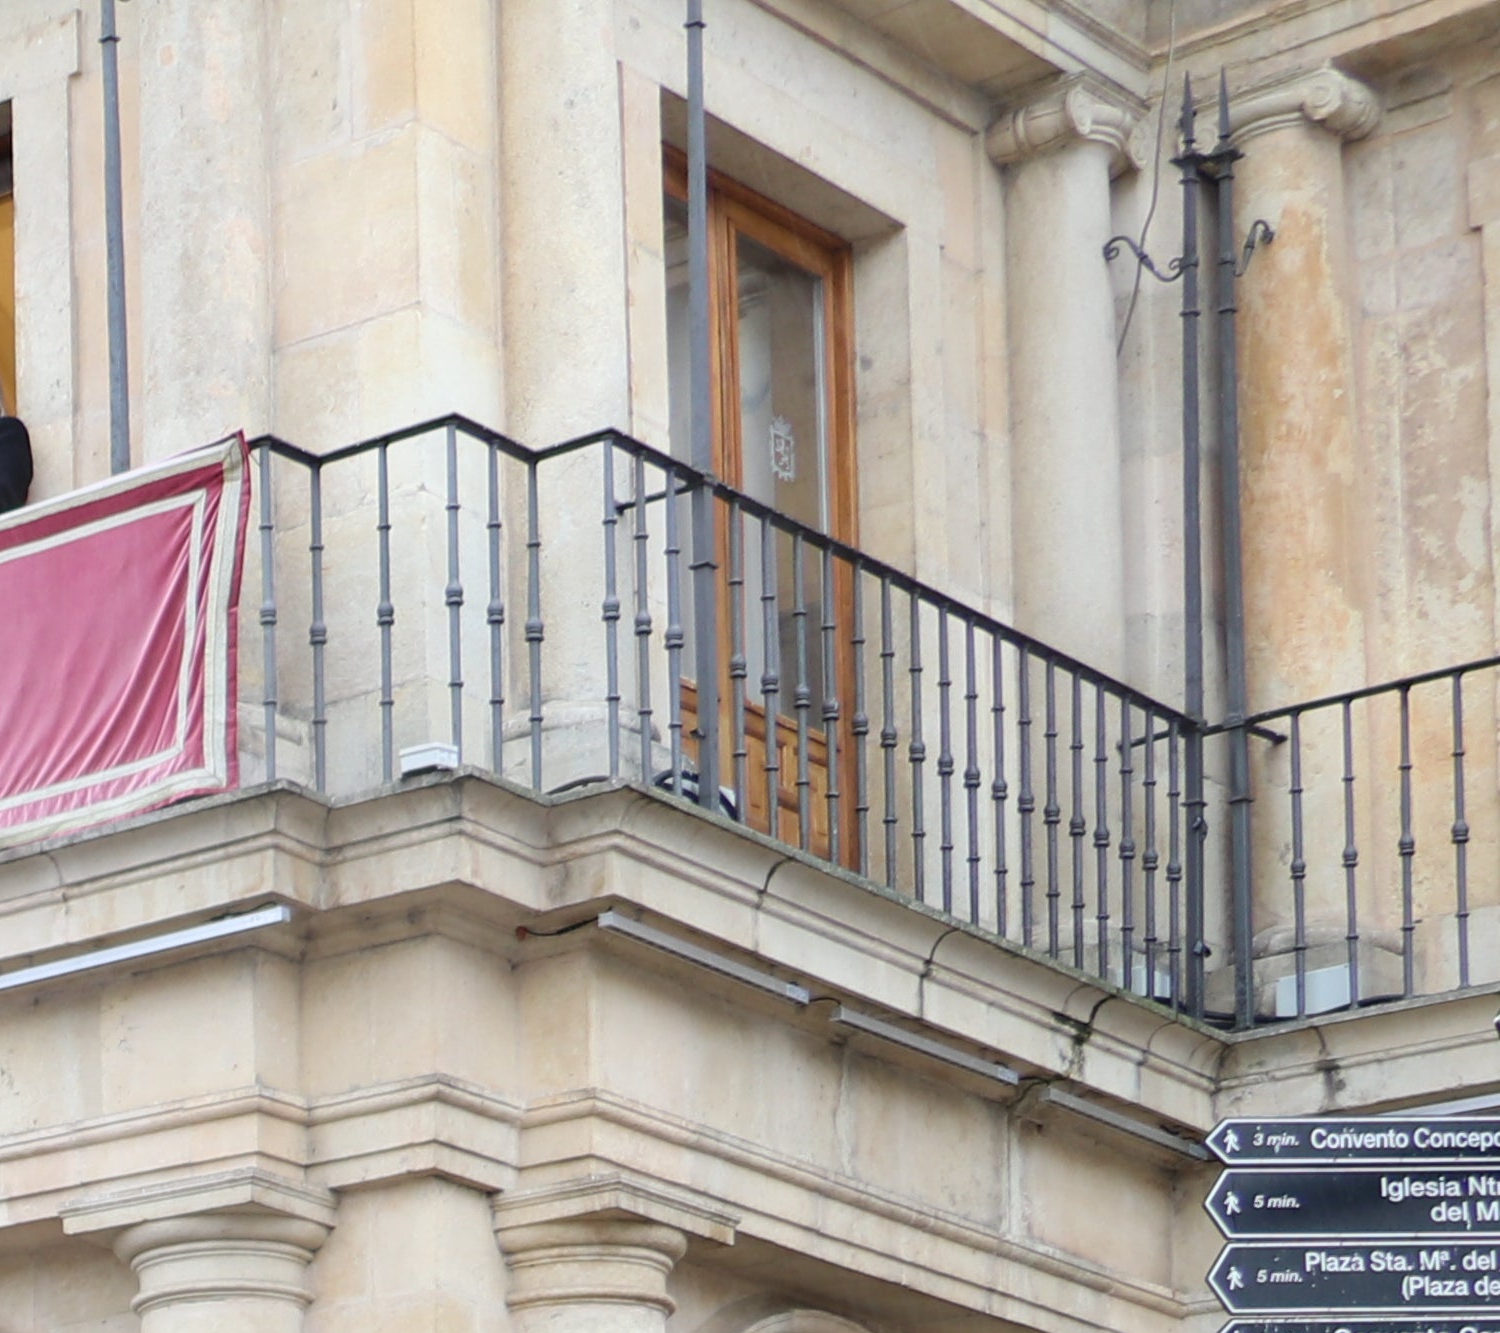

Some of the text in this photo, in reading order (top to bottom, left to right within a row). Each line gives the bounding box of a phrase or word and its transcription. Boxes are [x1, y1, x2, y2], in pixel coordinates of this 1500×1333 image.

[1253, 1132, 1300, 1146] 3 min.
[1310, 1128, 1409, 1149] Convento
[1381, 1176, 1461, 1202] Iglesia
[1253, 1194, 1300, 1208] 5 min.
[1430, 1201, 1469, 1221] del
[1304, 1251, 1365, 1272] Plaza
[1370, 1250, 1414, 1271] Sta.
[1462, 1250, 1496, 1271] del
[1257, 1269, 1303, 1283] 5 min.
[1402, 1275, 1470, 1301] (Plaza
